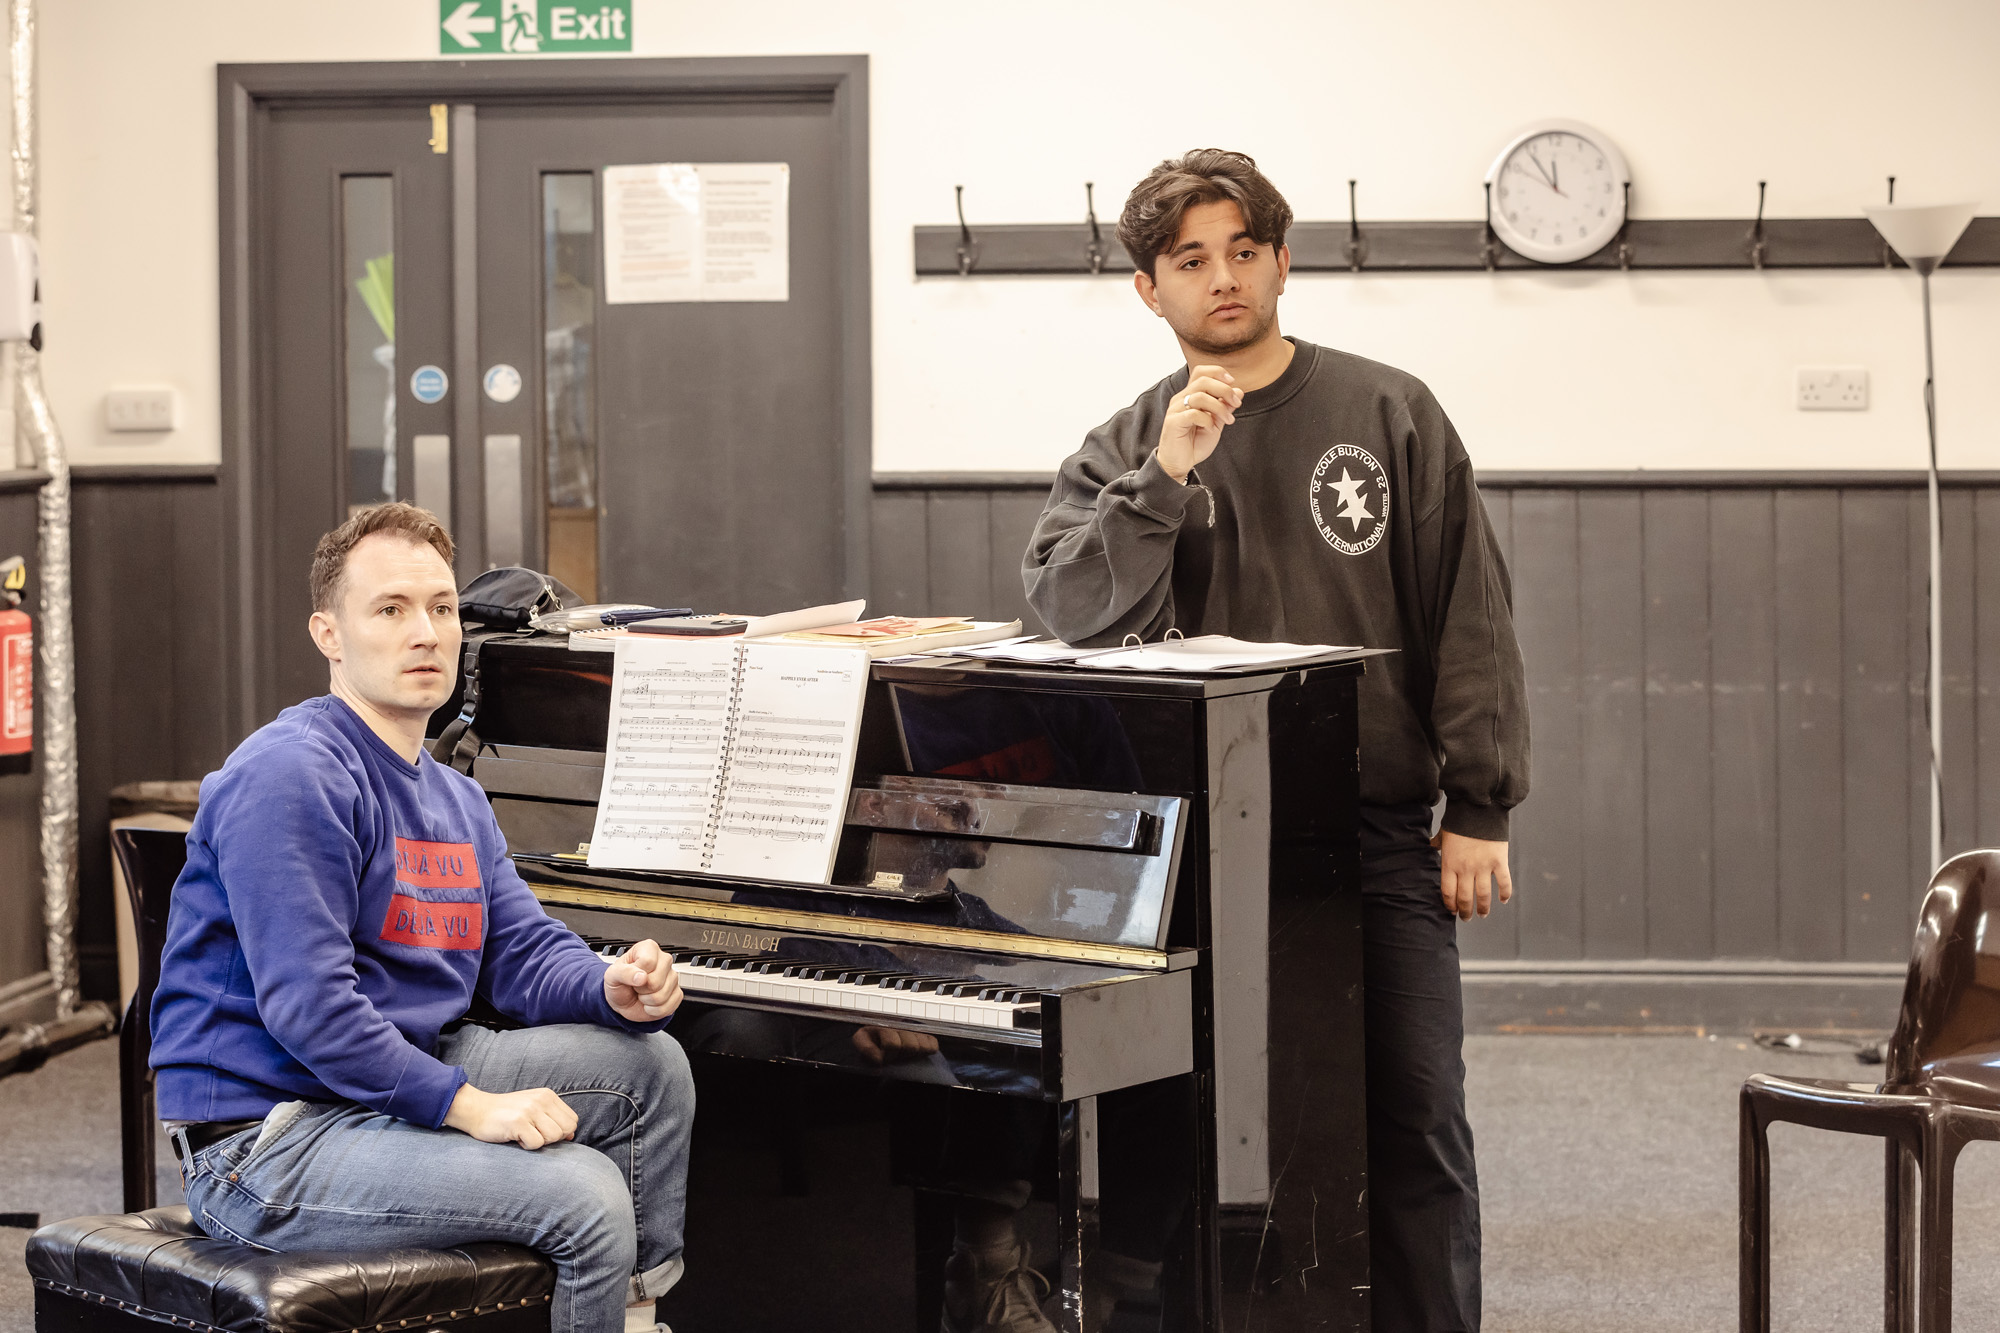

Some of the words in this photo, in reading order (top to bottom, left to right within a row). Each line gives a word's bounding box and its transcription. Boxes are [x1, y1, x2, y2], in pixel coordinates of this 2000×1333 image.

[551, 6, 626, 41] Exit
[1316, 450, 1338, 476] COLE
[1337, 447, 1378, 472] BUXTON
[1312, 480, 1321, 493] 20
[1376, 475, 1386, 488] 23
[1322, 521, 1385, 553] INTERNATIONAL
[396, 845, 430, 876] DÉJÀ
[436, 855, 464, 876] VU
[395, 906, 438, 937] DÉJÀ
[443, 916, 469, 938] VU
[701, 929, 781, 952] STEINBACH
